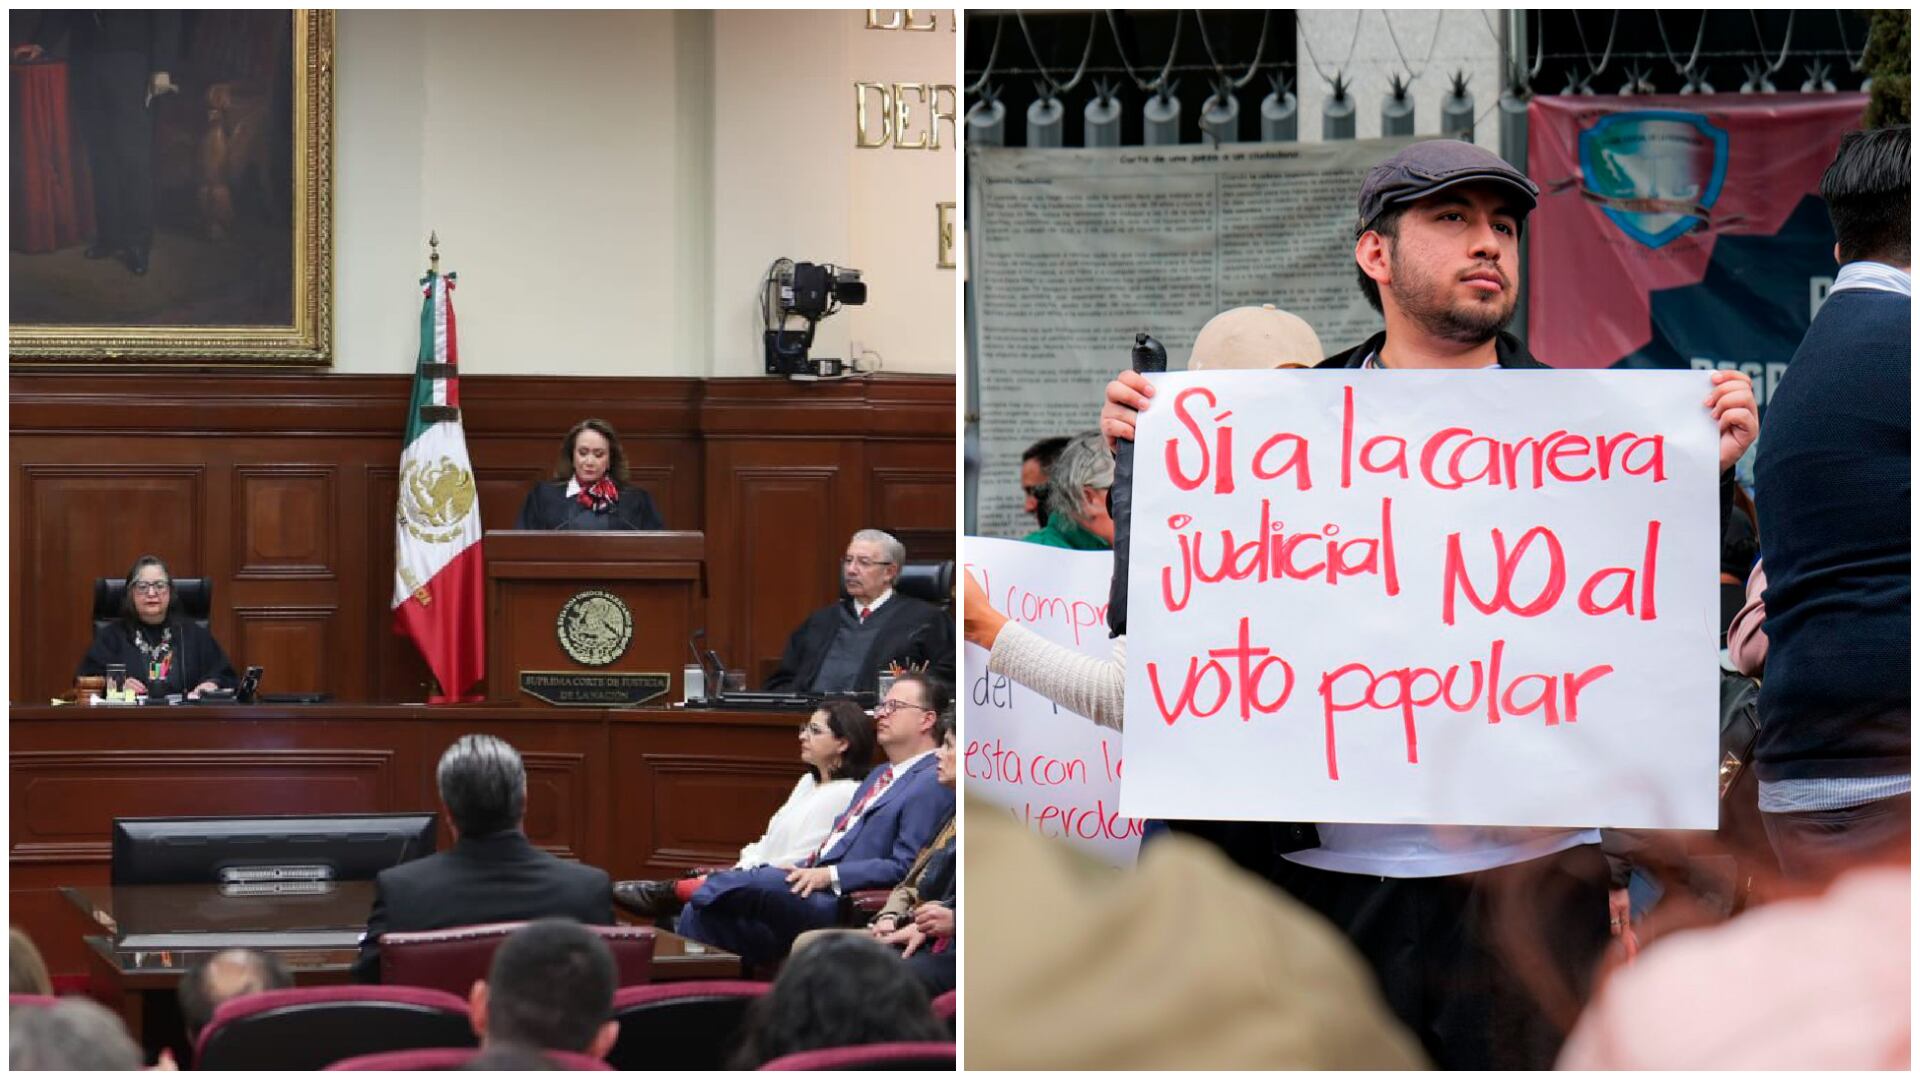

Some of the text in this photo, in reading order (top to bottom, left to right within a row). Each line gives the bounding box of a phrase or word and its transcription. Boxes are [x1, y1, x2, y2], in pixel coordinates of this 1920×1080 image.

[1153, 153, 1164, 162] de
[1164, 386, 1236, 495] Sí
[1251, 432, 1313, 492] a
[1340, 384, 1410, 489] la
[1419, 426, 1668, 491] carrera
[1161, 496, 1401, 613] judicial
[1442, 525, 1567, 627] NO
[1577, 519, 1662, 622] al
[1146, 616, 1615, 782] voto popular
[964, 739, 1023, 785] esta
[1031, 755, 1086, 785] con
